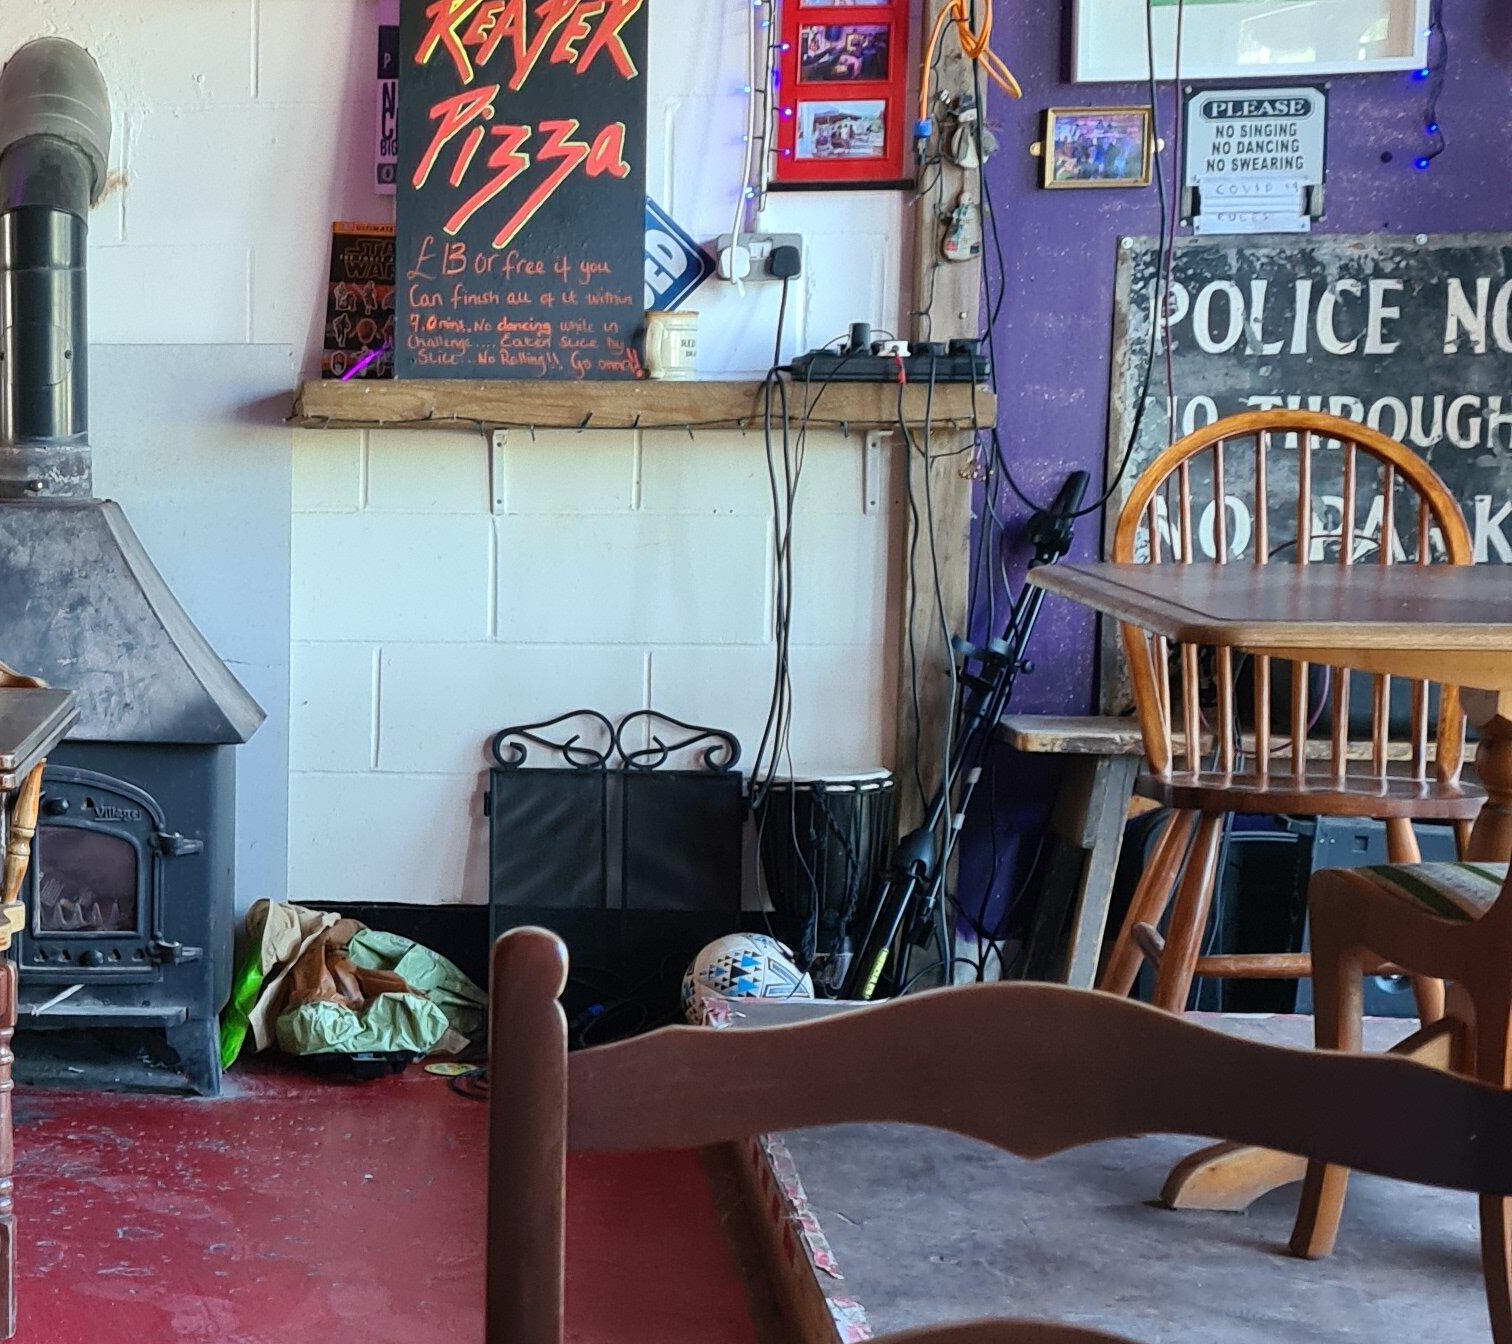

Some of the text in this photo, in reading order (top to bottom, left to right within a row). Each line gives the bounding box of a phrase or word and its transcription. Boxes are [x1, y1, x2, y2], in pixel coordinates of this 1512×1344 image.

[1209, 98, 1307, 118] PLEASE
[1214, 122, 1299, 139] NO SINGING
[1210, 138, 1301, 156] NO DANCING
[1205, 155, 1304, 173] NO SWEARING
[474, 253, 499, 274] or
[500, 251, 545, 281] free
[579, 258, 612, 285] you
[408, 279, 555, 310] Can finish all of
[495, 313, 552, 336] dancing
[1149, 277, 1404, 356] POLICE
